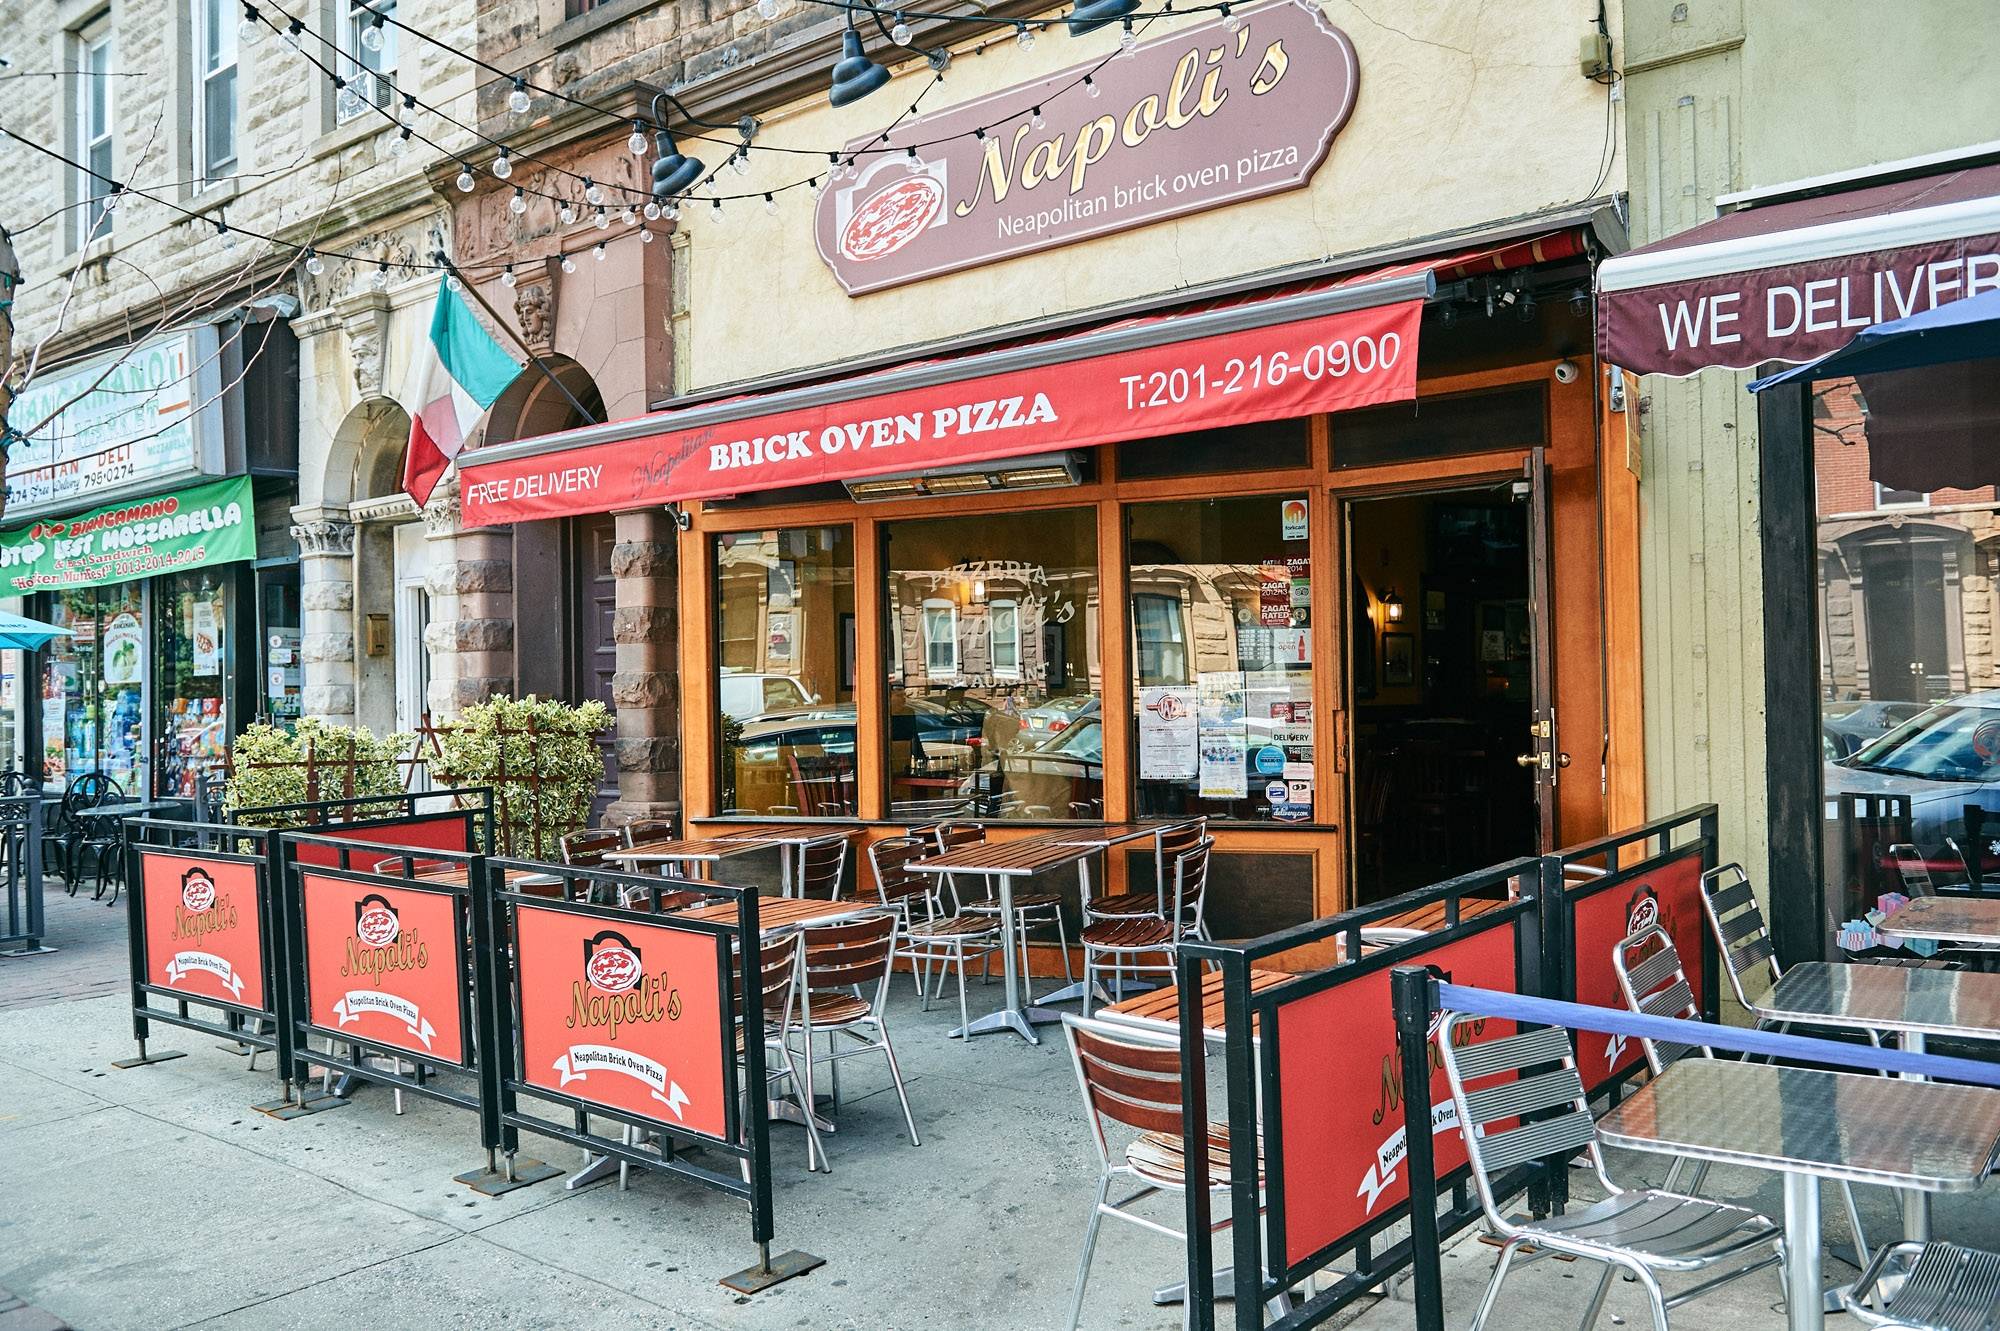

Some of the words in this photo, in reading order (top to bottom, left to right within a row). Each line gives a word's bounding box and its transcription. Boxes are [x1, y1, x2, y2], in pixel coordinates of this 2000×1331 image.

[955, 25, 1290, 218] Napoli's
[997, 195, 1108, 240] Neapolitan
[1114, 173, 1168, 210] brick
[1172, 163, 1227, 196] oven
[1237, 144, 1299, 190] pizza
[1659, 293, 1741, 350] WE
[1119, 332, 1401, 409] T:201-216-0900
[708, 431, 812, 472] BRICK
[820, 413, 925, 455] OVEN
[932, 392, 1059, 439] PIZZA
[467, 479, 509, 506] FREE
[513, 464, 604, 499] DELIVERY
[101, 502, 242, 551] MOZZARELLA
[89, 546, 152, 564] Sandwich
[931, 560, 1049, 592] PIZZERIA
[903, 582, 1076, 651] Napoli's
[1261, 604, 1289, 612] ZAGAT
[1261, 612, 1289, 620] RATED
[1274, 733, 1309, 742] DELIVERY
[172, 894, 238, 946] Napoli's
[340, 928, 428, 986] Napoli's
[375, 996, 389, 1008] Brick
[389, 1000, 403, 1012] Oven
[403, 1004, 417, 1020] Pizza
[566, 971, 683, 1040] Napoli's
[574, 1049, 608, 1066] Neapolitan
[608, 1051, 627, 1067] Brick
[627, 1057, 645, 1073] Oven
[645, 1063, 664, 1083] Pizza
[1437, 1109, 1455, 1124] Oven
